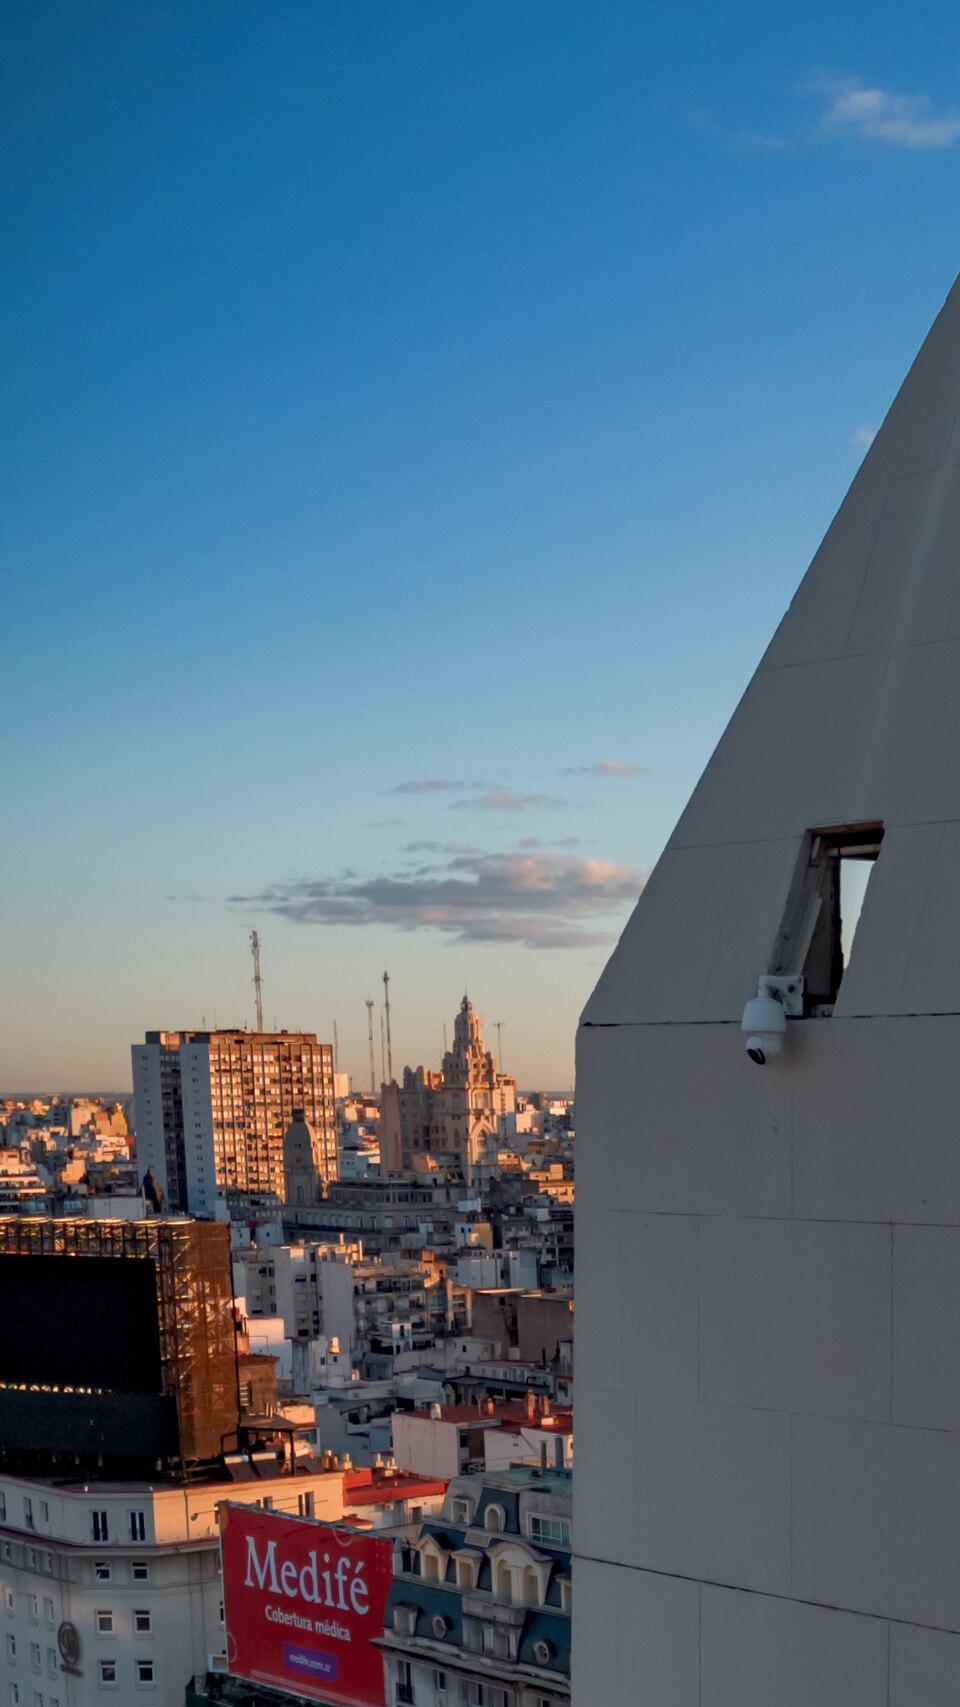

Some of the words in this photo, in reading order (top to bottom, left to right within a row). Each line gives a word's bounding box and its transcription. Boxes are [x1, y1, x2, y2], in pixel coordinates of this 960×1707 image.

[244, 1536, 369, 1615] Medifé
[265, 1605, 312, 1632] Cobertura
[314, 1619, 351, 1642] médica
